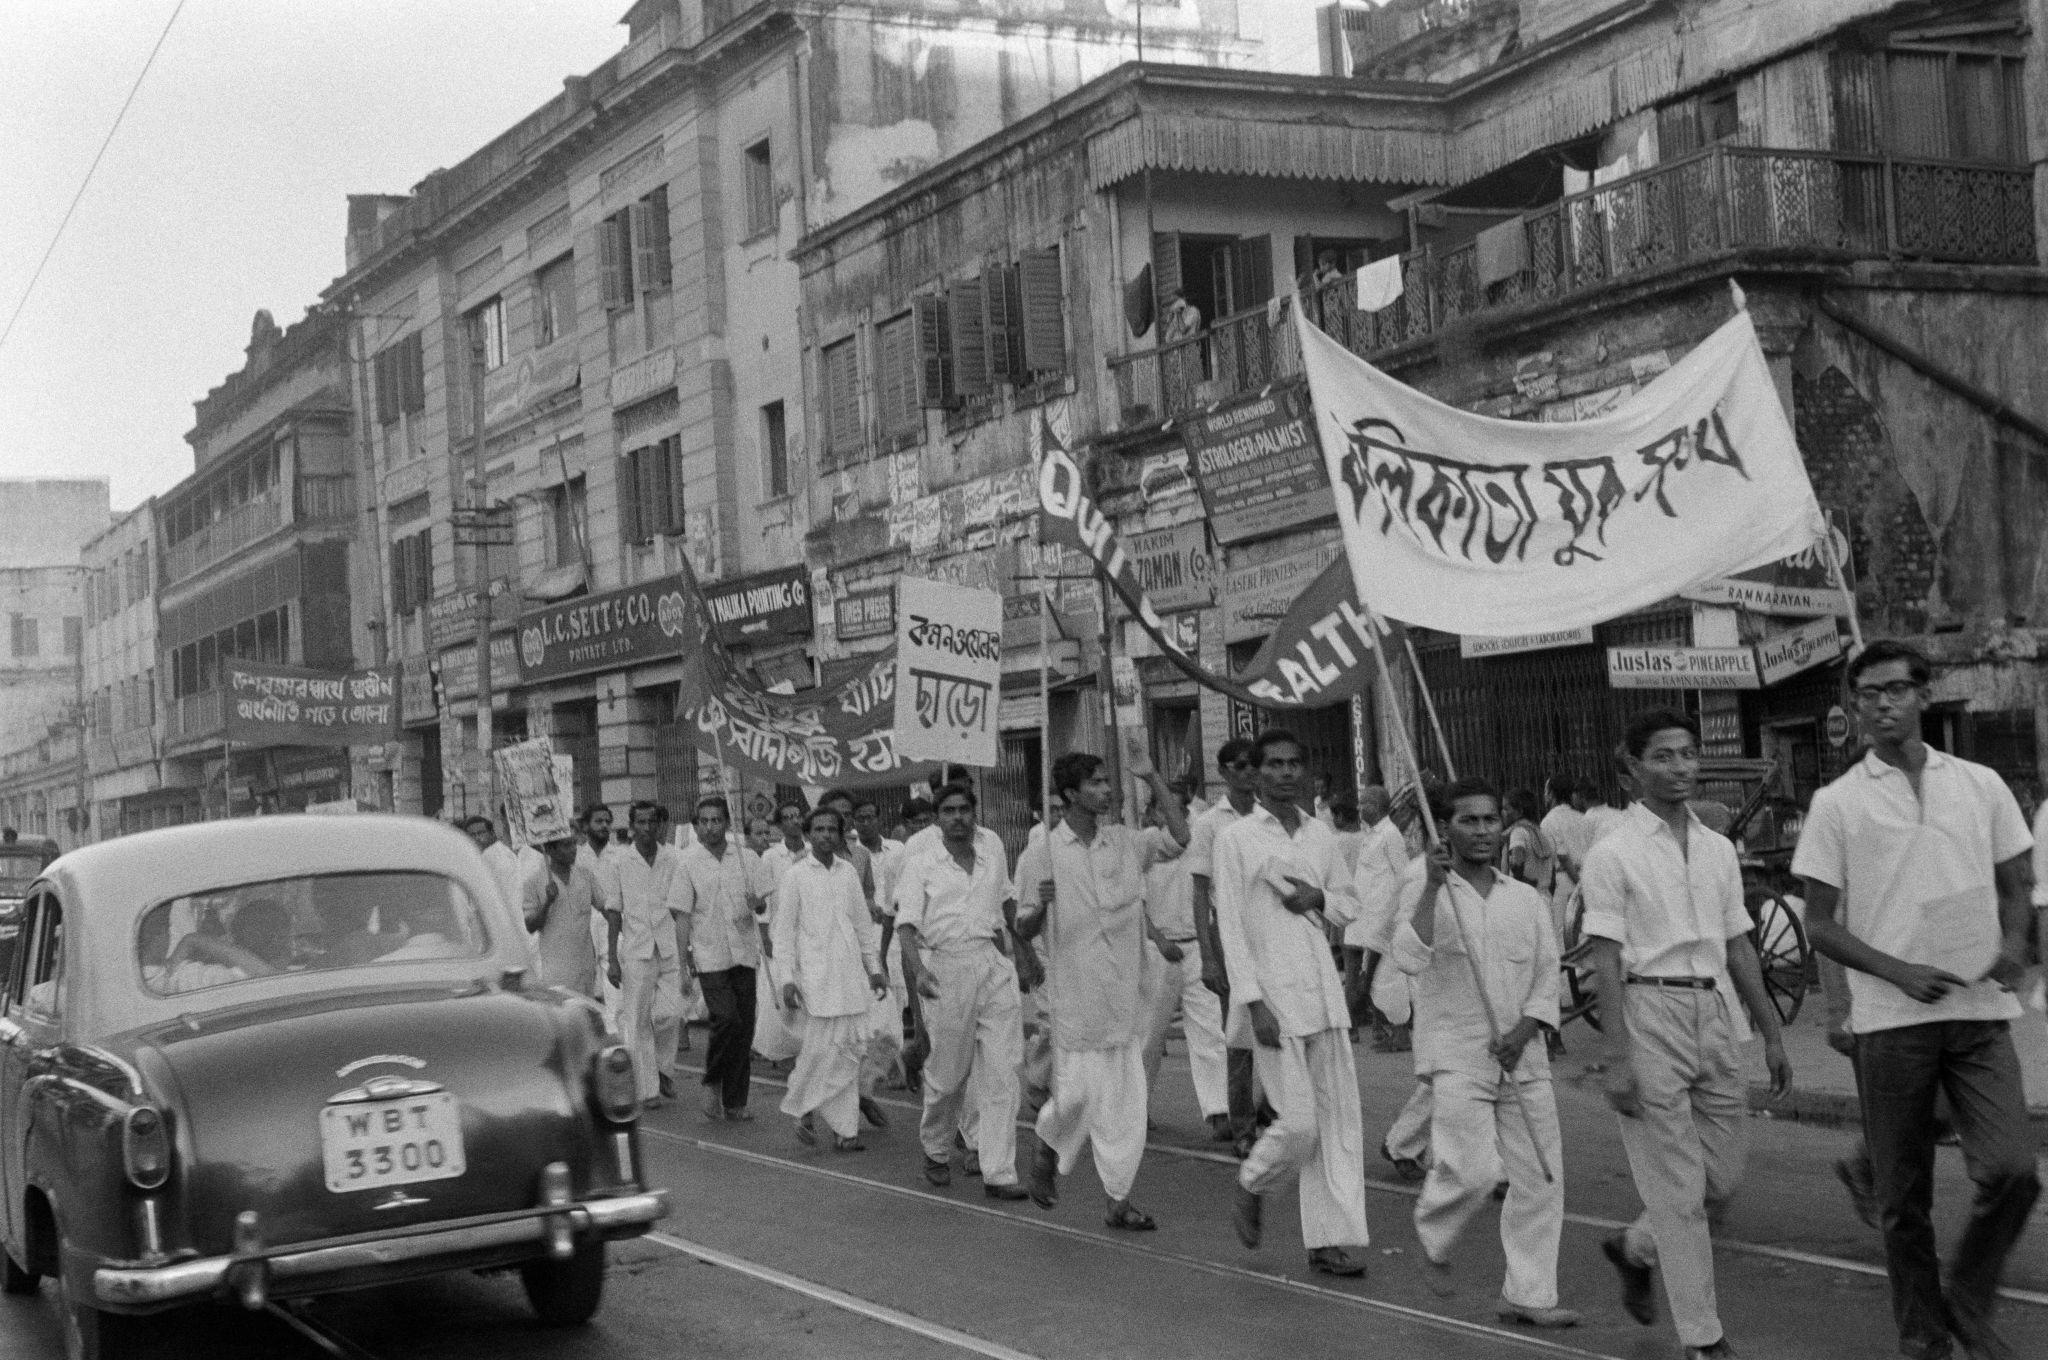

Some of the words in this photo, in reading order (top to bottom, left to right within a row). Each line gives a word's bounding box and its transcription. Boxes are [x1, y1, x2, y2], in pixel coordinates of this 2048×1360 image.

[1206, 412, 1233, 432] WORLD
[1232, 399, 1275, 424] RENOWNED
[1255, 419, 1307, 457] PALMIST
[746, 582, 792, 617] PRINTING
[1727, 587, 1811, 608] RAMNARAYAN
[568, 641, 607, 663] PRIVATE
[1536, 628, 1582, 646] LABORATORIES
[1688, 655, 1750, 672] PINEAPPLE
[909, 667, 992, 740] ছাড়ো
[345, 1104, 429, 1138] WBT
[345, 1138, 446, 1180] 3300
